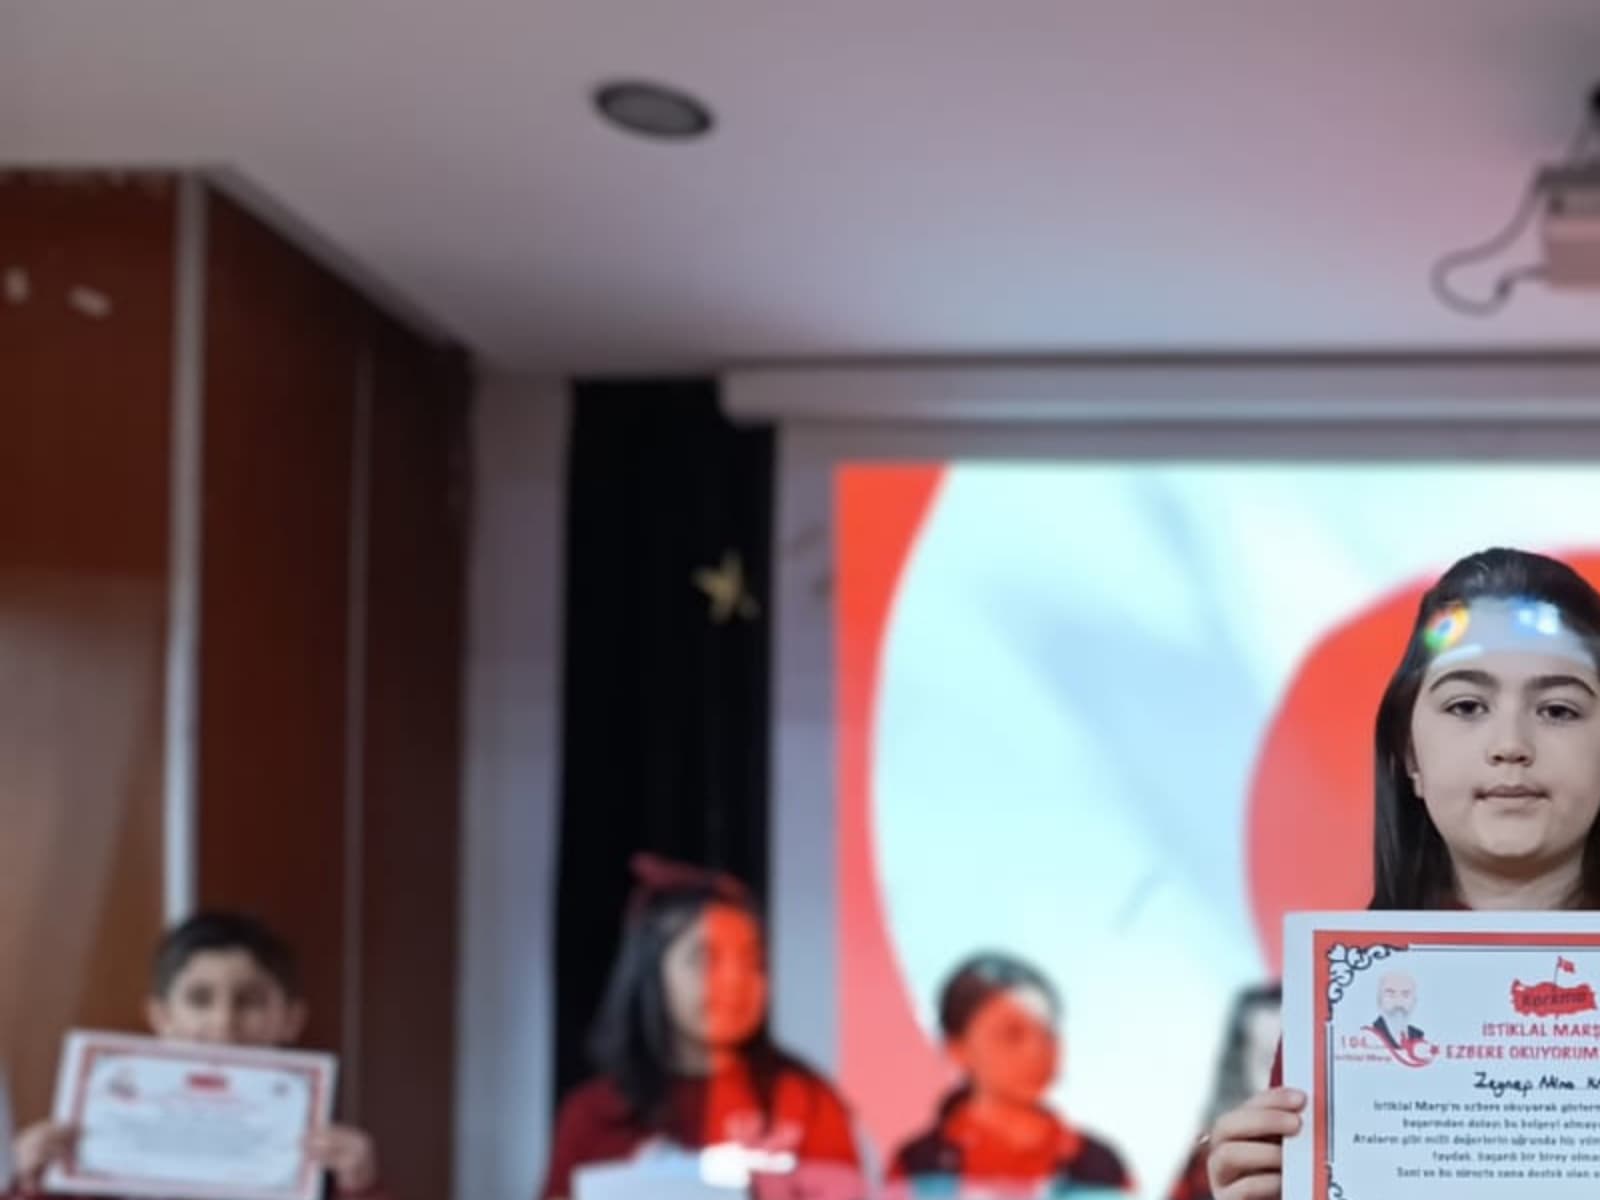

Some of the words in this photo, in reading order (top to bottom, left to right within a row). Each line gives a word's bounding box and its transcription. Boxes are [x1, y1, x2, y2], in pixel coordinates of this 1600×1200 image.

[1446, 1044, 1504, 1060] EZBERE
[1509, 1044, 1599, 1060] OKUYORUM
[1473, 1071, 1533, 1098] Zeynep
